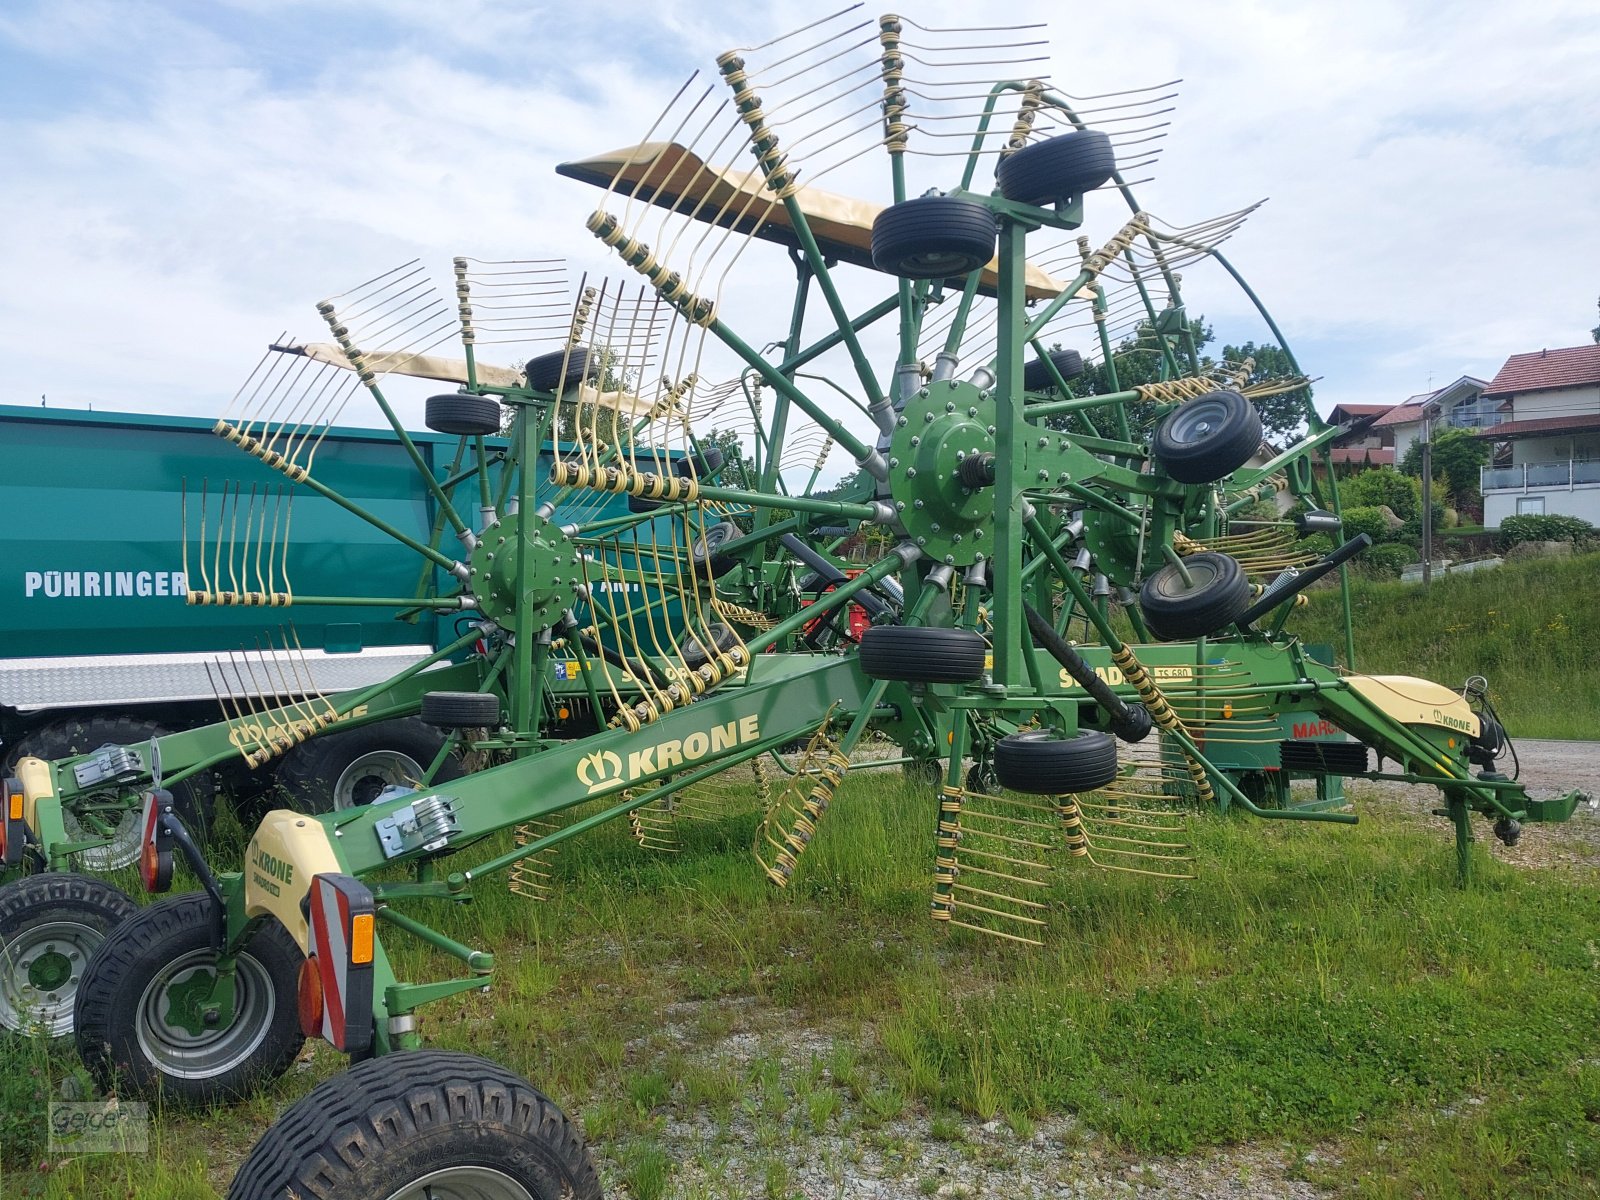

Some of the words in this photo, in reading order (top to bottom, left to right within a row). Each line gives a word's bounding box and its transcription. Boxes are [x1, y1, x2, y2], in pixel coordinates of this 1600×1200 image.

[25, 571, 187, 598] PÜHRINGER
[1171, 668, 1188, 678] 680
[1443, 715, 1471, 731] KRONE
[629, 714, 760, 781] KRONE
[259, 850, 293, 885] KRONE
